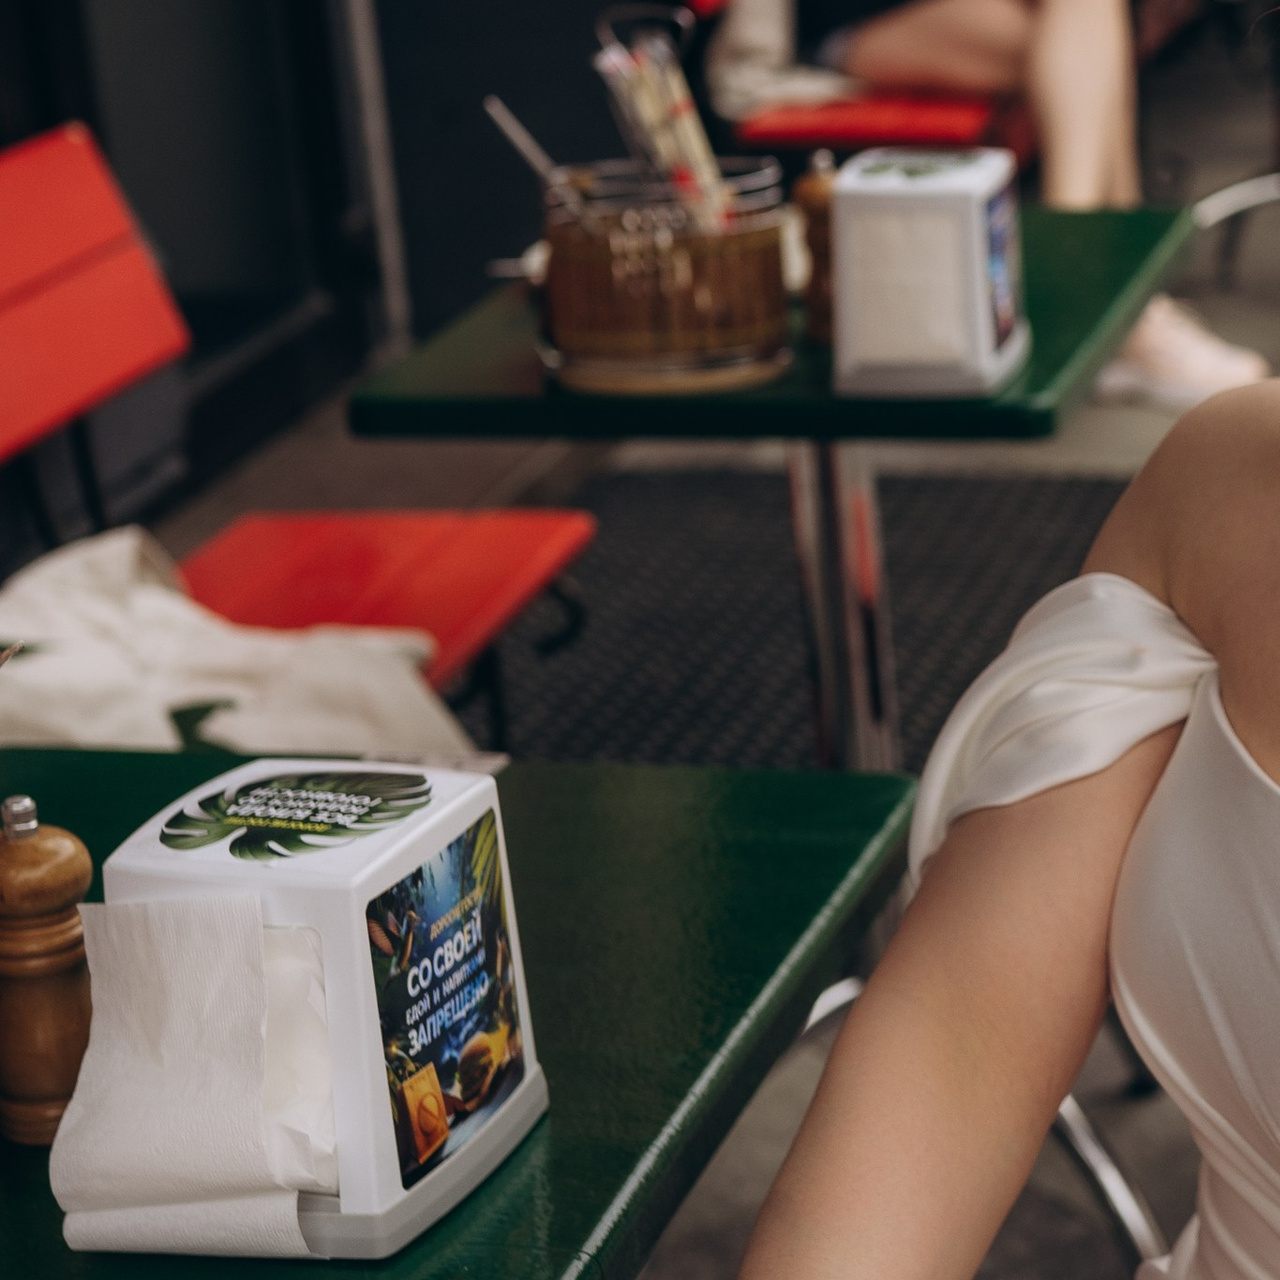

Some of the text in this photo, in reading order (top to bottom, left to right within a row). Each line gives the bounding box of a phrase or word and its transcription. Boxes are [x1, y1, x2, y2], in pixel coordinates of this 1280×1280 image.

[407, 907, 483, 998] СО СВОЕЙ
[406, 992, 431, 1026] ЕДОЙ
[433, 988, 441, 1006] И
[408, 970, 490, 1057] ЗАПРЕЩЕНО
